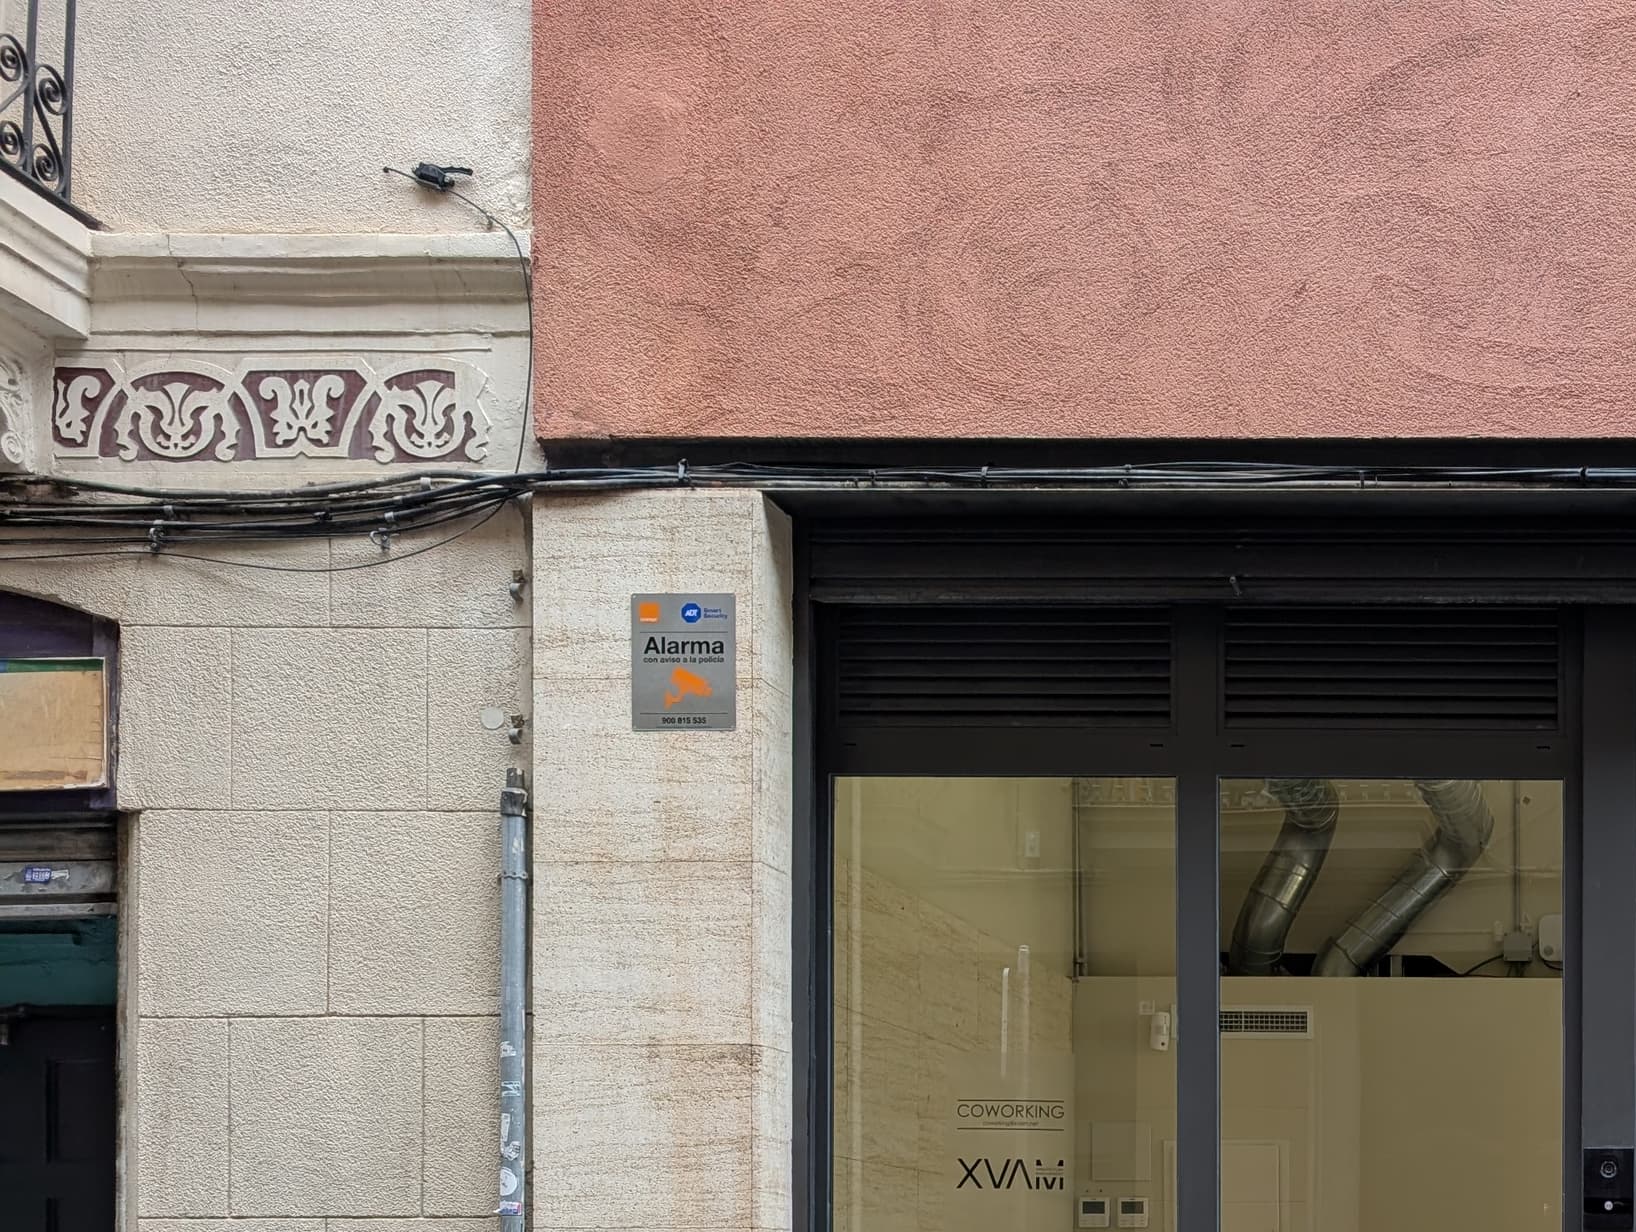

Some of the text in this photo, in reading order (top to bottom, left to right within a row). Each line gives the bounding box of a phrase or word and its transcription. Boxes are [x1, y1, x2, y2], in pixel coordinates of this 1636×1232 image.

[643, 636, 725, 655] Alarma
[956, 1103, 1065, 1119] COWORKING
[956, 1158, 1065, 1190] XVAM
